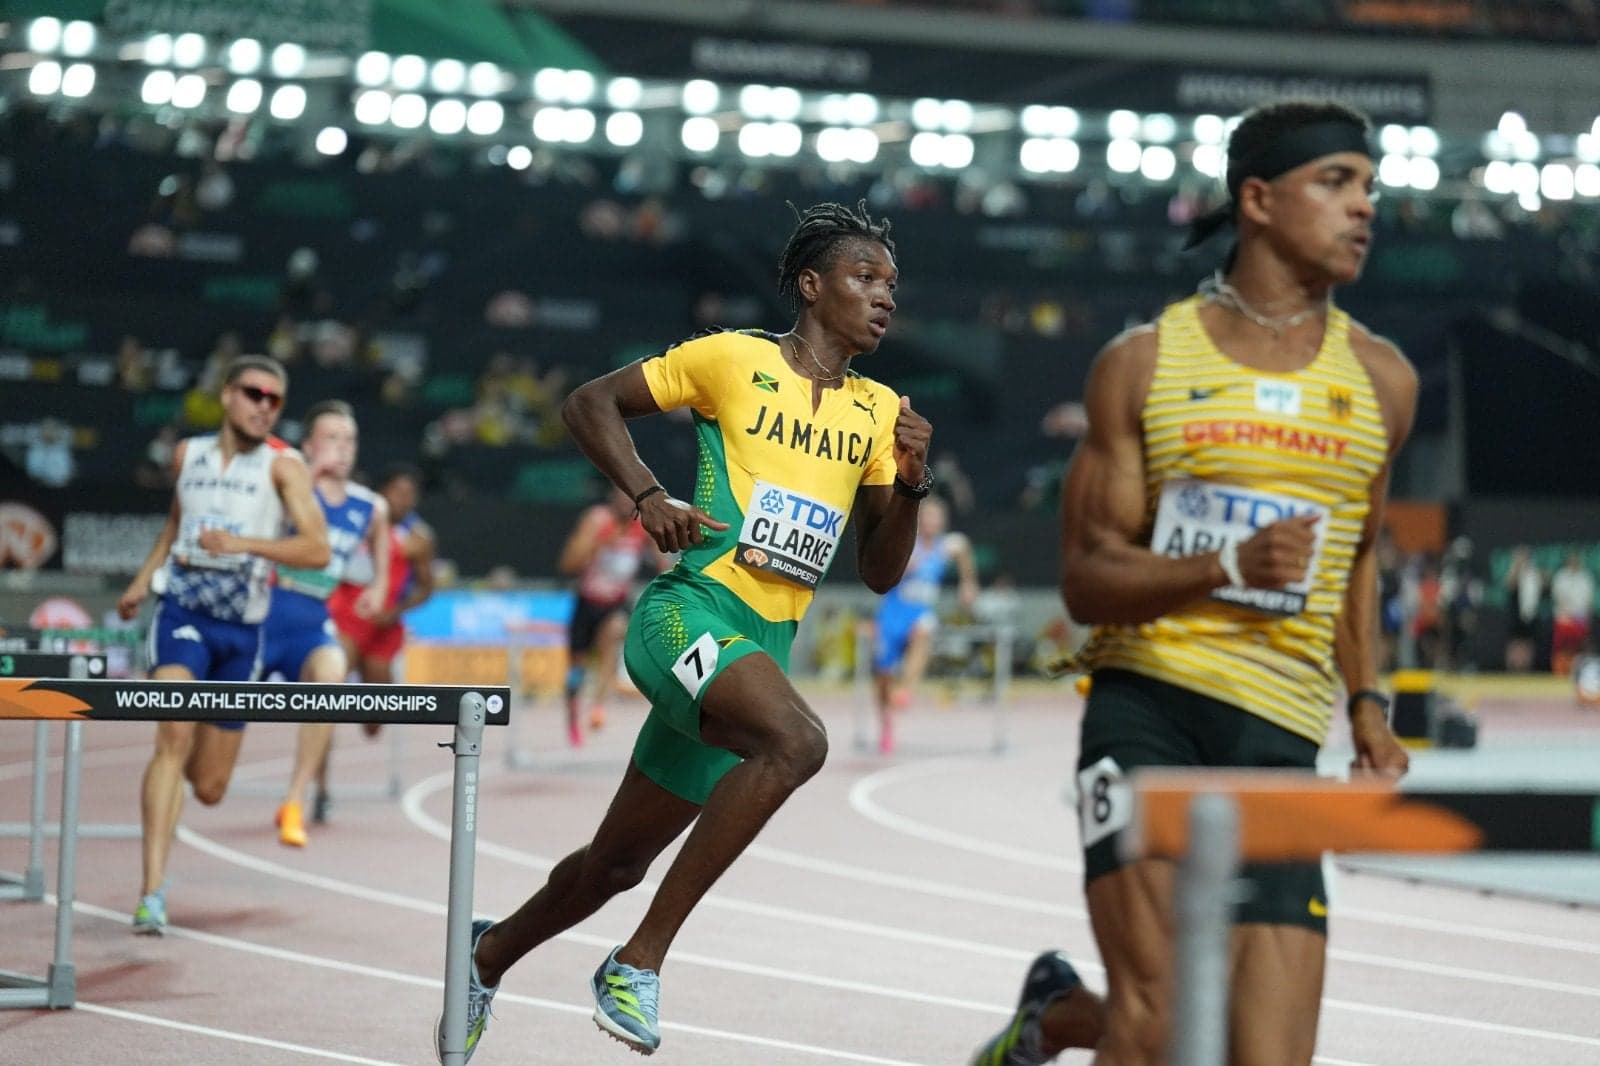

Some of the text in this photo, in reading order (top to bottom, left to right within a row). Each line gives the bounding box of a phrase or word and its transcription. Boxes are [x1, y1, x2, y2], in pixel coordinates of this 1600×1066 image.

[745, 405, 873, 468] JAMAICA
[1183, 420, 1349, 461] GERMANY
[786, 494, 844, 538] TDK
[751, 517, 833, 568] CLARKE
[684, 646, 704, 680] 7
[115, 690, 438, 712] WORLD ATHLETICS CHAMPIONSHIPS
[1092, 775, 1111, 824] 8
